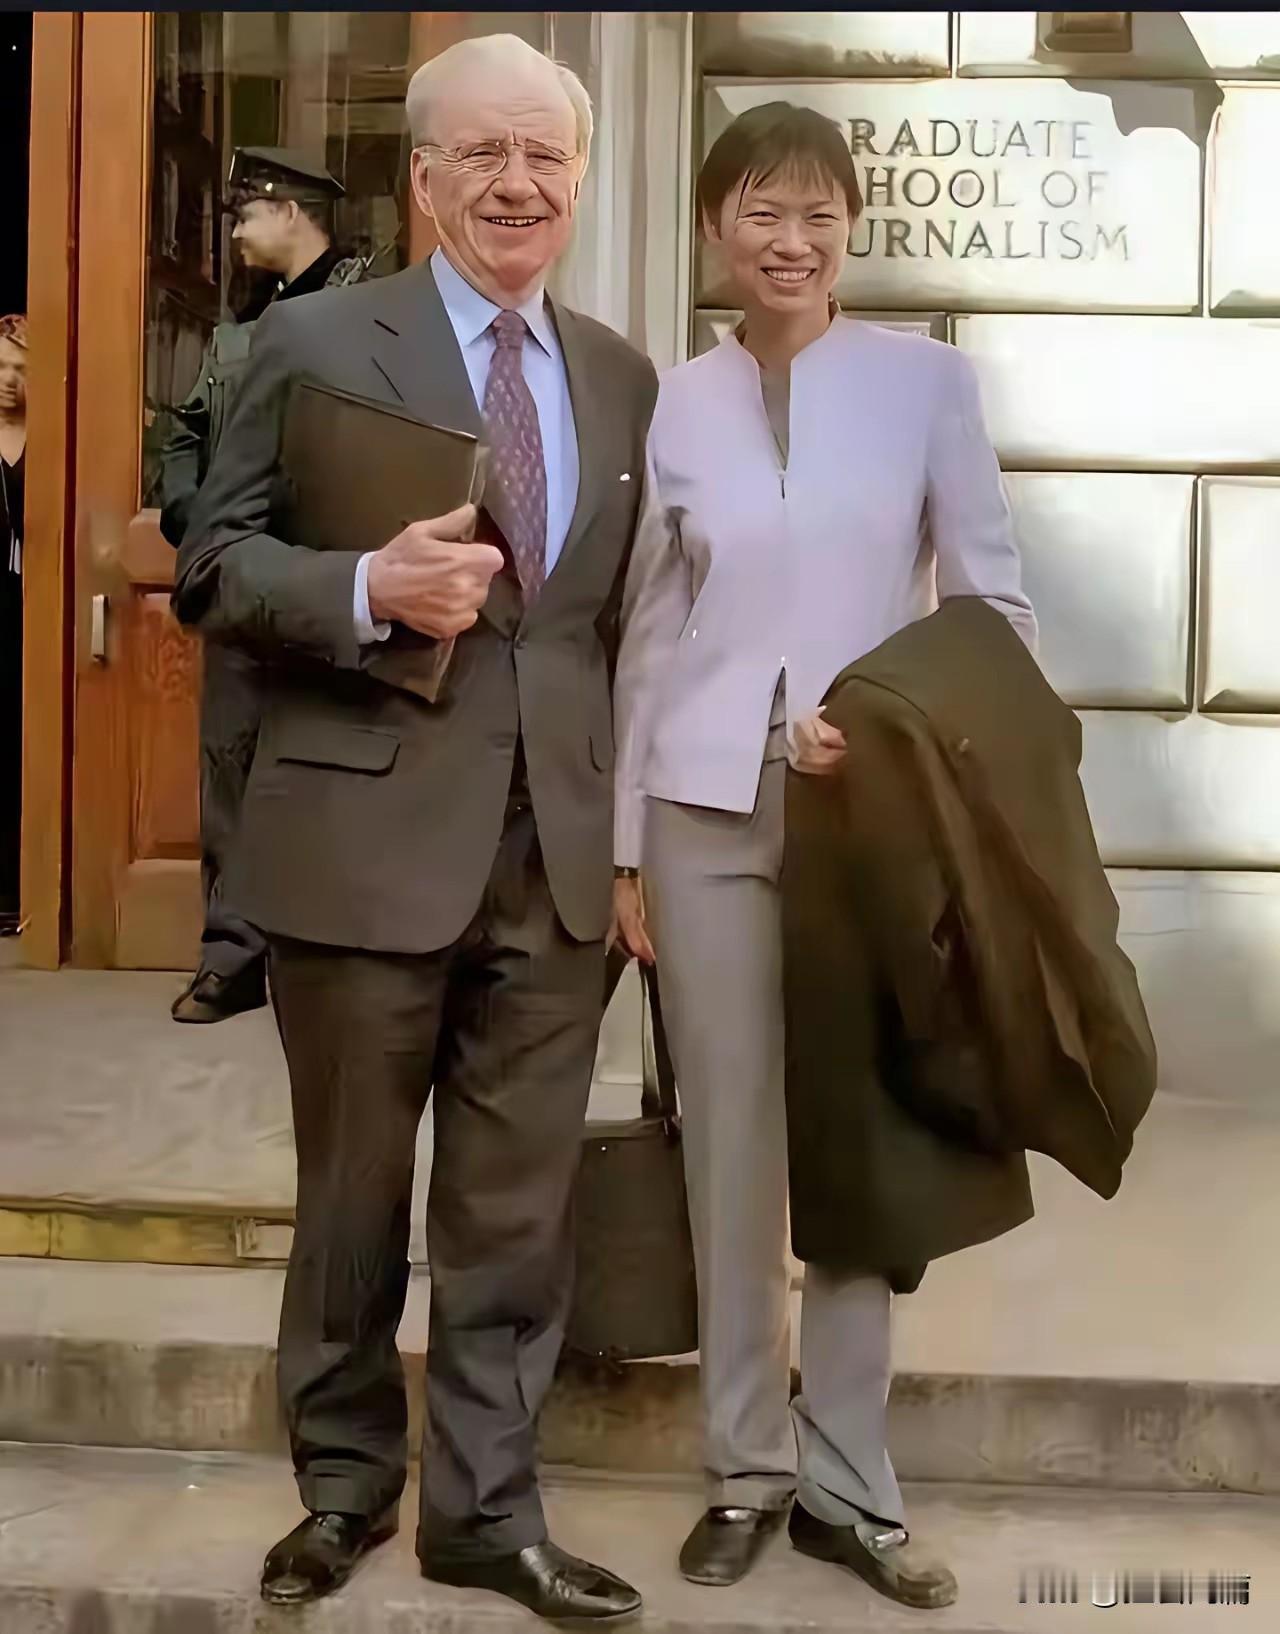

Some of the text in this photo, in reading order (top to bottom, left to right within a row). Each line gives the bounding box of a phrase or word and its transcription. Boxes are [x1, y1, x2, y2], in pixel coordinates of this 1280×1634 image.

[848, 118, 1092, 159] RADUATE
[864, 166, 1109, 208] HOOL OF
[847, 217, 1130, 261] URNALISM
